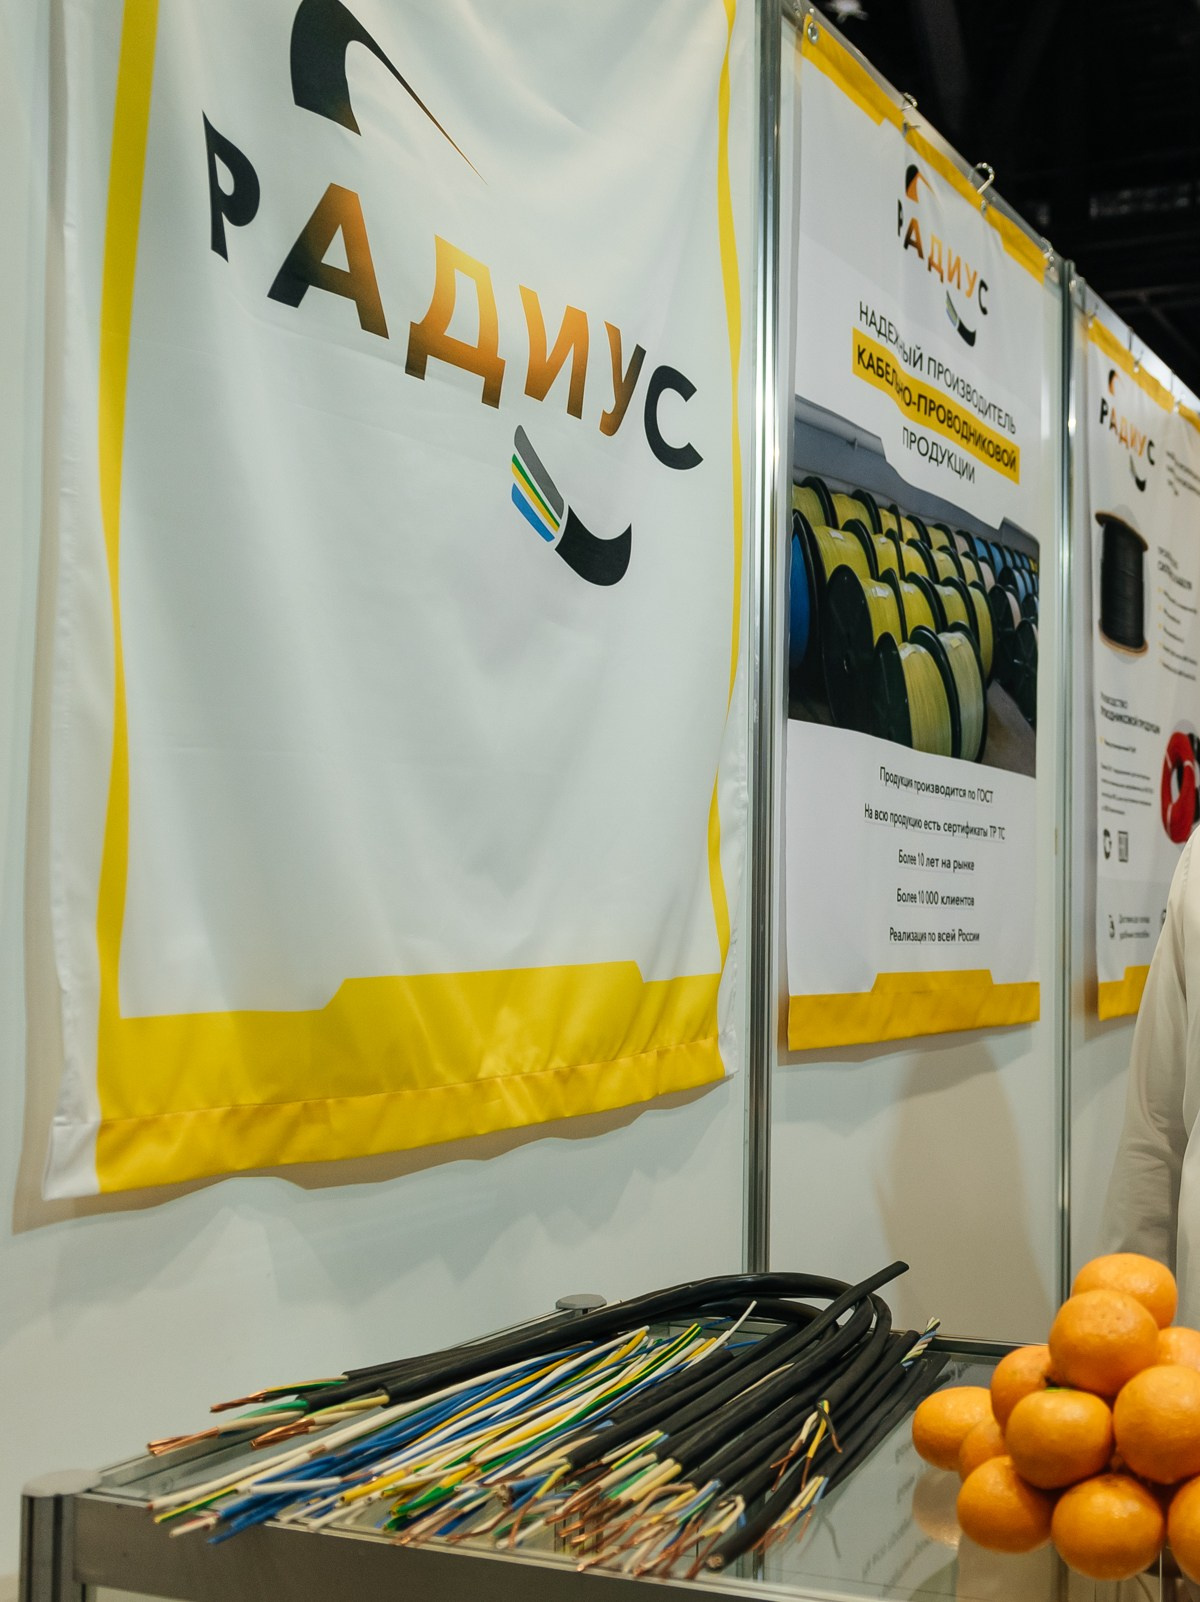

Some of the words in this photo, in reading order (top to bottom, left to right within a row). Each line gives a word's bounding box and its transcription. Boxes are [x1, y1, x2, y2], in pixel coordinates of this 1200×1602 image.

[897, 199, 989, 315] РАДИУС
[201, 109, 704, 471] РАДИУС
[927, 357, 1016, 435] ПРОИЗВОДИТЕЛЬ
[902, 427, 976, 484] ПРОДУКЦИИ
[880, 766, 913, 789] Продукция
[968, 789, 976, 801] по
[977, 788, 993, 803] ГОСТ
[864, 803, 873, 819] На
[874, 809, 888, 822] всю
[890, 812, 922, 830] продукцию
[924, 821, 941, 831] есть
[943, 821, 988, 839] сертификаты
[989, 825, 997, 839] ТР
[998, 826, 1005, 840] ТС
[898, 849, 916, 866] Более
[917, 852, 925, 866] 10
[925, 856, 940, 868] лет
[941, 858, 951, 869] на
[953, 859, 975, 873] рынке
[896, 888, 917, 904] Более
[940, 893, 975, 907] клиентов
[889, 927, 927, 944] Реализация
[928, 932, 936, 943] по
[937, 929, 956, 942] всей
[957, 929, 980, 942] России
